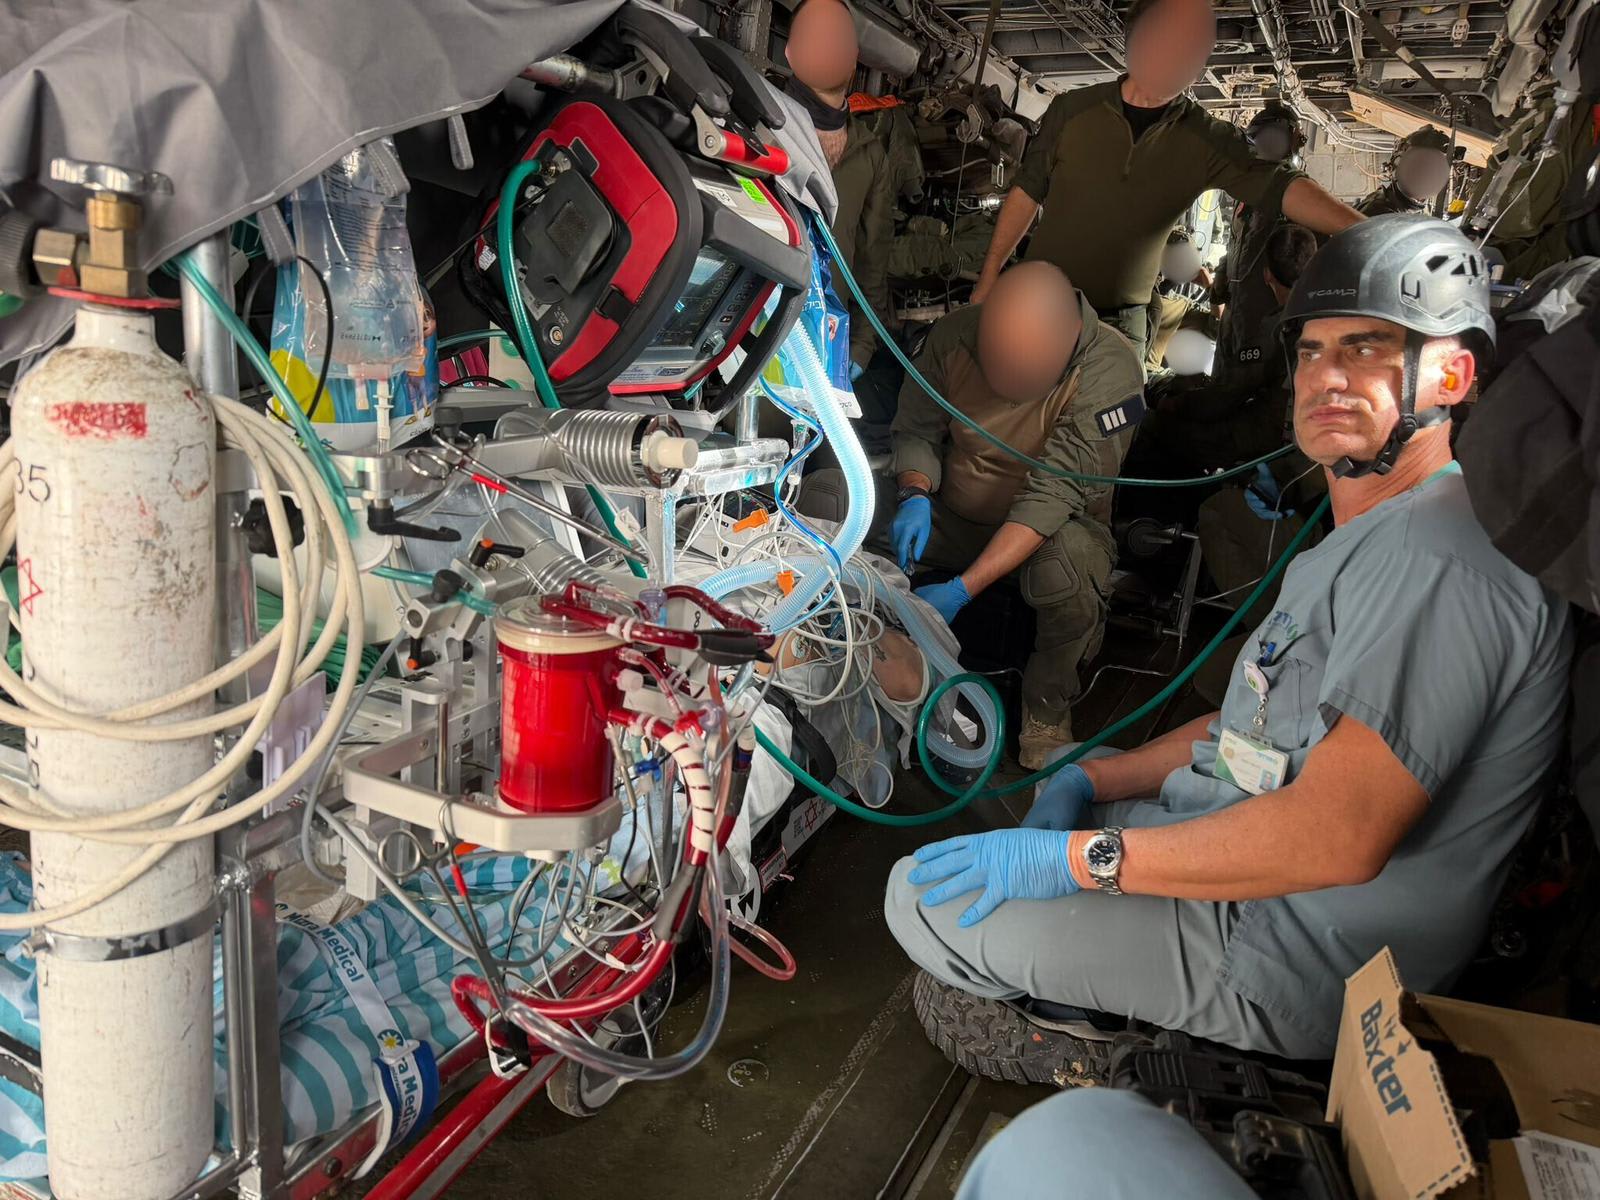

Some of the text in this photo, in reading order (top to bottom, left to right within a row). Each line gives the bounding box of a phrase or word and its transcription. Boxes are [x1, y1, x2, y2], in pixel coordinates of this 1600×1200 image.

[1240, 348, 1260, 361] 669
[283, 911, 365, 982] Mizra Medical
[1361, 998, 1412, 1116] Baxter
